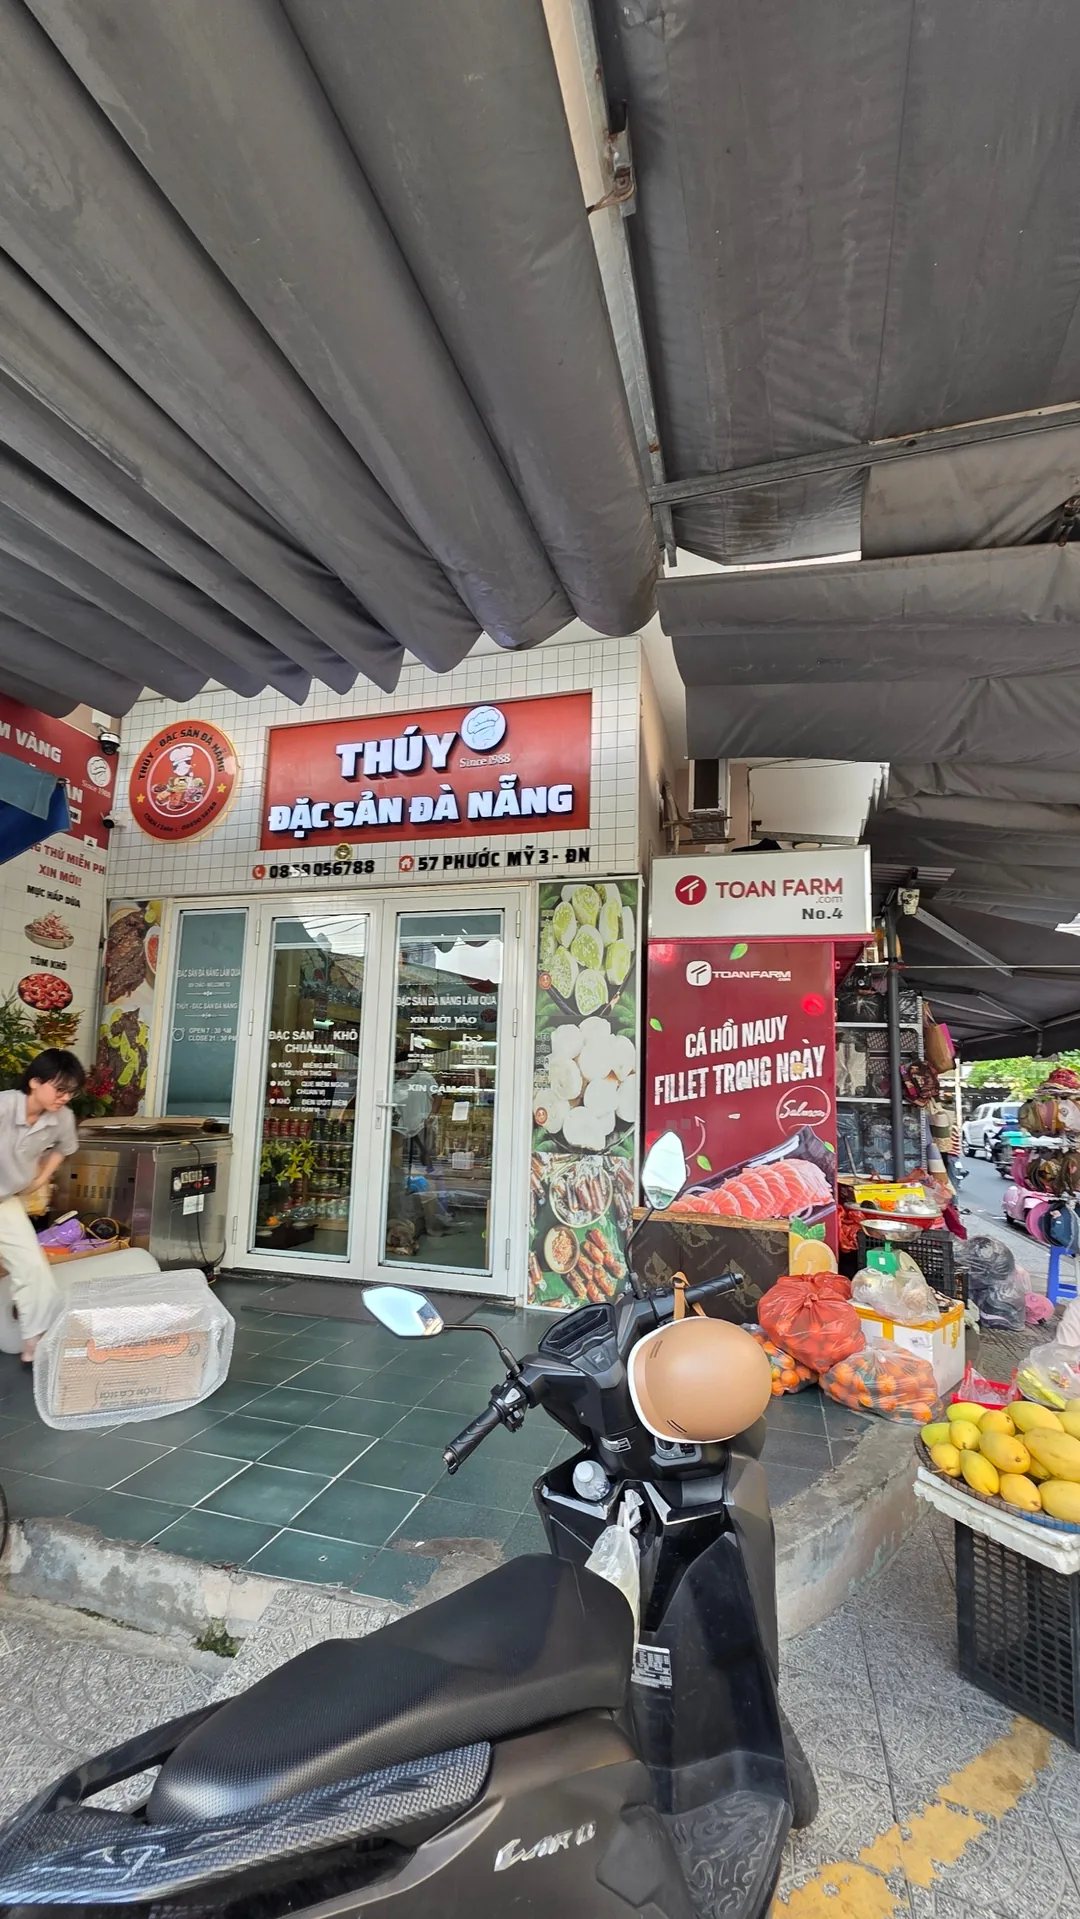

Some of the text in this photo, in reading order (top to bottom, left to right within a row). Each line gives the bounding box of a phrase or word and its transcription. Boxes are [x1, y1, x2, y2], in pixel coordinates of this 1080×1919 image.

[16, 728, 62, 763] VÀNG
[159, 731, 178, 748] ĐẶC
[180, 726, 200, 738] SẢN
[335, 725, 458, 781] THÚY
[460, 753, 511, 768] Since 1988
[268, 773, 574, 839] ĐẶC SẢN ĐÀ NẴNG
[66, 853, 91, 870] MIỄN
[93, 864, 106, 876] PH
[418, 856, 438, 871] 57
[443, 847, 500, 870] PHƯỚC
[507, 845, 535, 867] MỸ
[539, 849, 549, 864] 3
[565, 847, 591, 863] ĐN
[39, 864, 57, 879] XIN
[715, 877, 843, 899] TOAN FARM
[815, 896, 843, 904] .com
[801, 907, 843, 920] No.4
[430, 1014, 452, 1023] MỜI
[454, 1014, 477, 1023] VÀO
[269, 1029, 358, 1041] ĐẶC SẢN KHÔ
[685, 1015, 788, 1058] CÁ HỒI NAUY
[654, 1038, 826, 1105] FILLET TRONG NGÀY
[408, 1084, 427, 1092] XIN
